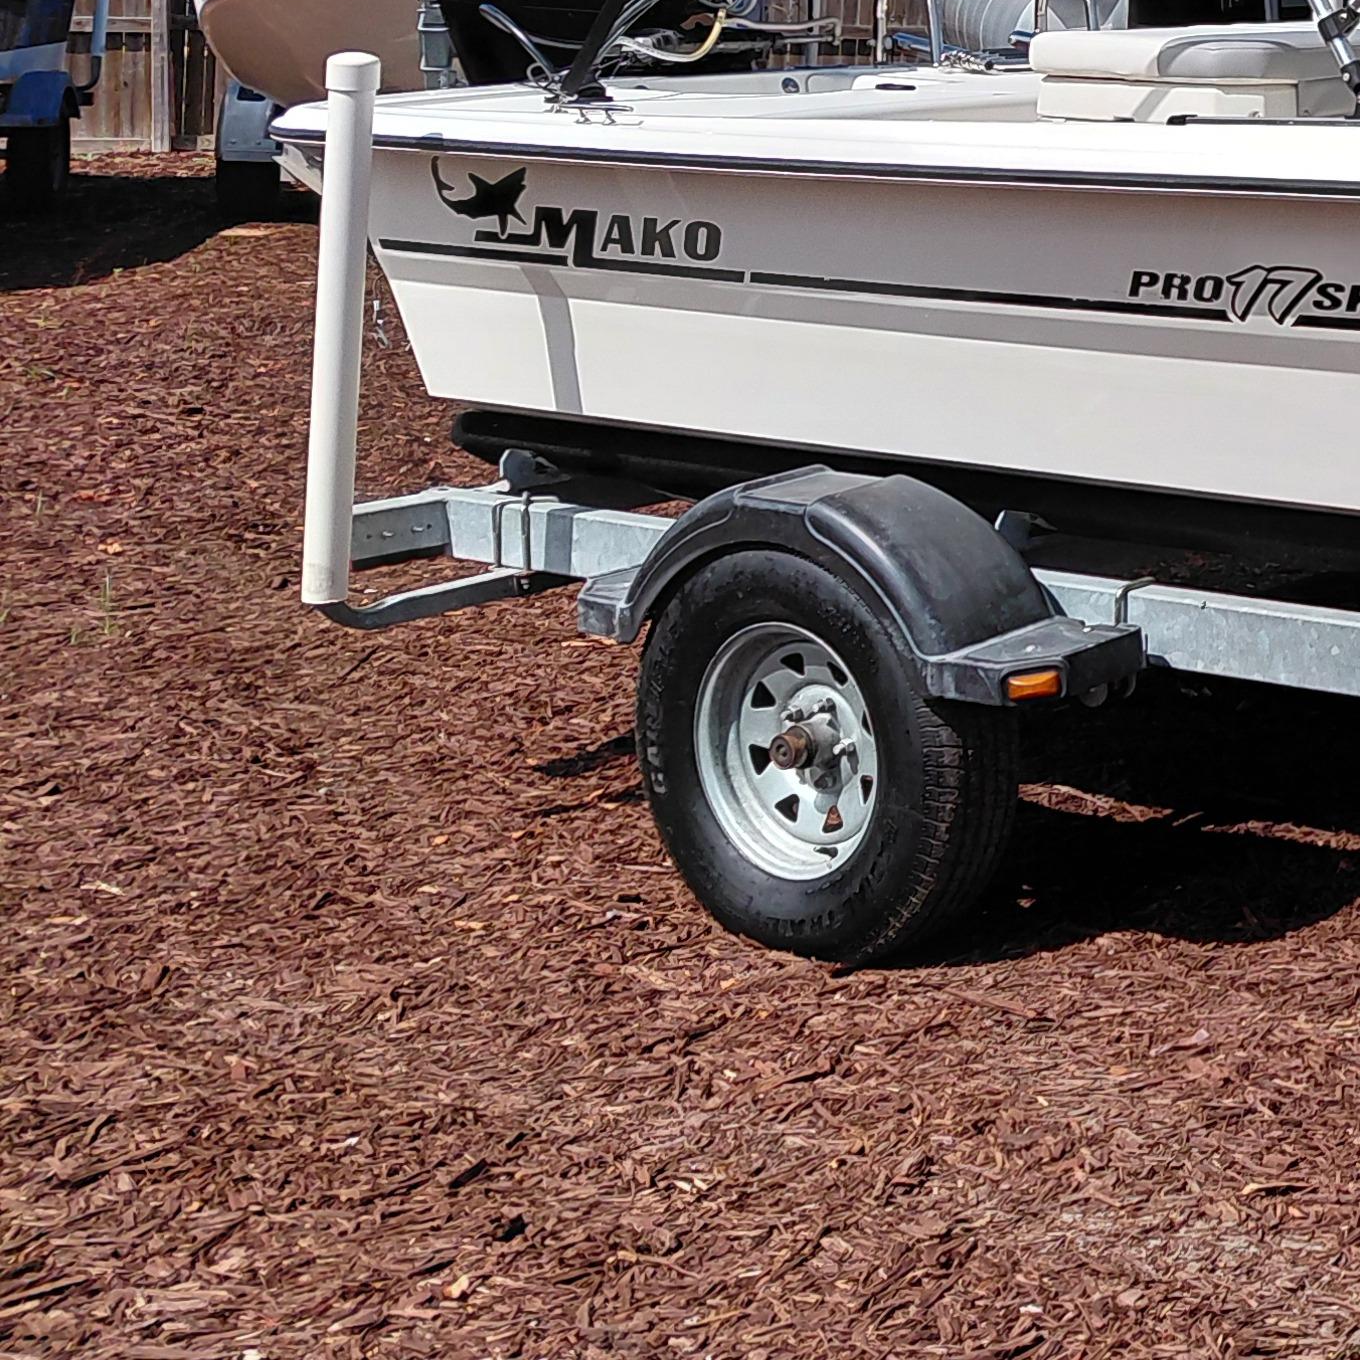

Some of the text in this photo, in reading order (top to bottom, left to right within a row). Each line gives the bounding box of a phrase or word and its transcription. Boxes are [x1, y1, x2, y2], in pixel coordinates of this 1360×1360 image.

[531, 205, 723, 266] MAKO
[1128, 270, 1225, 303] PRO
[1225, 264, 1323, 326] 17
